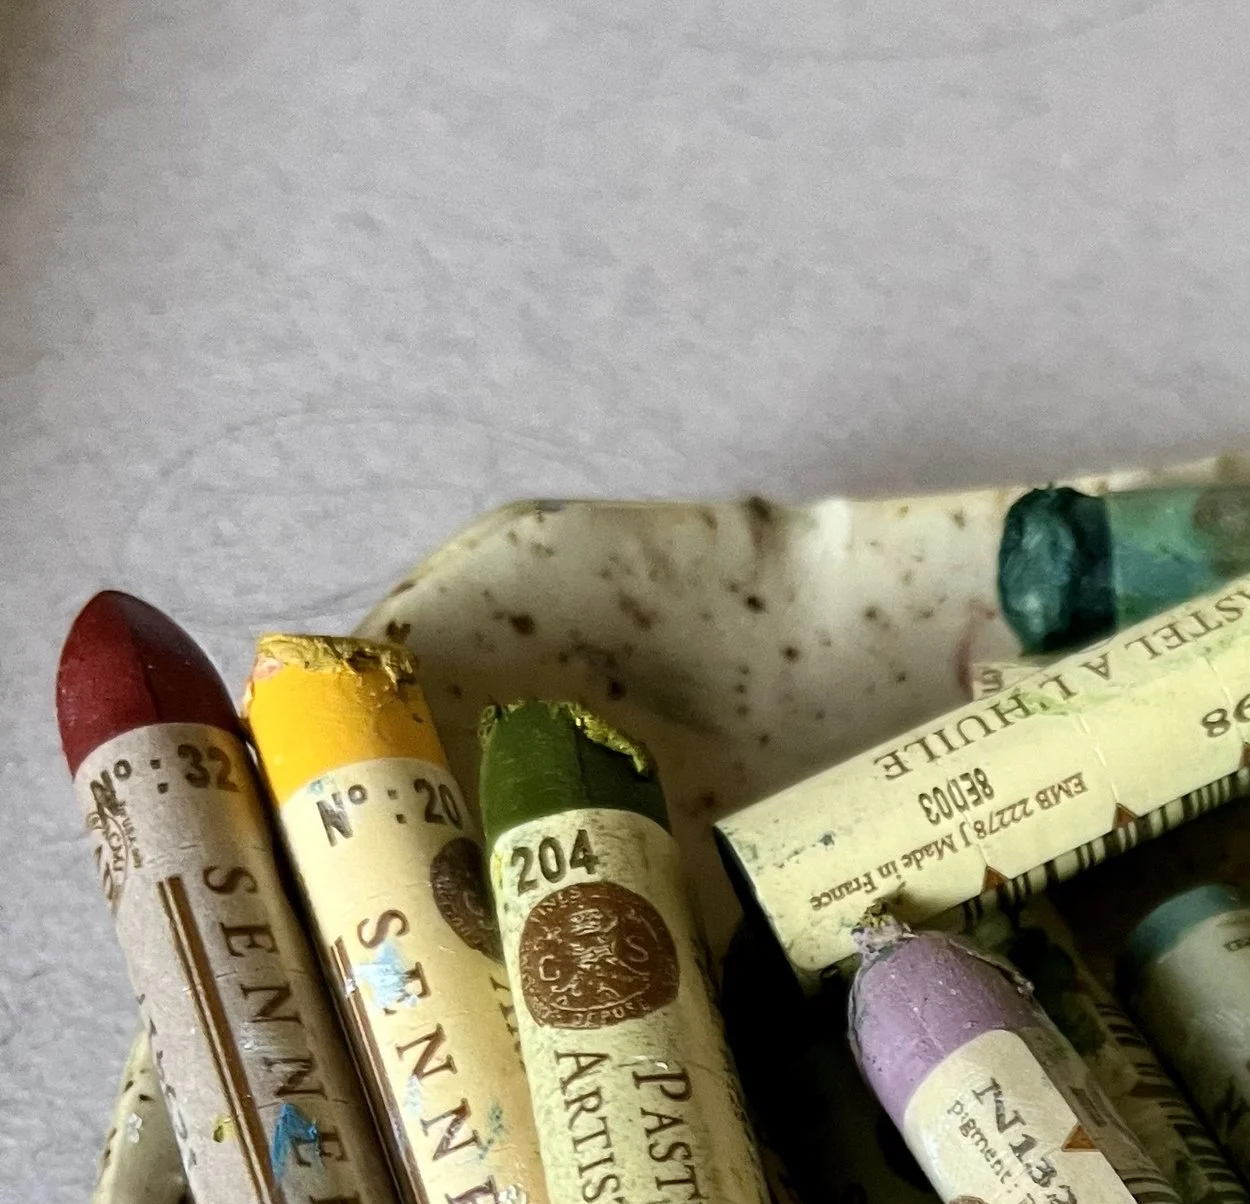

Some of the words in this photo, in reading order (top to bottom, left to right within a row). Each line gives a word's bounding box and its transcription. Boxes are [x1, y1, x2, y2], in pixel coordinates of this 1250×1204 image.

[1077, 649, 1120, 691] A
[868, 670, 1070, 786] L'HUILE
[177, 744, 246, 793] 32
[1029, 769, 1089, 812] EMB
[414, 778, 462, 831] 20
[969, 796, 1037, 842] 22278
[510, 829, 599, 897] 204
[872, 857, 902, 887] in
[897, 831, 959, 877] Made
[808, 869, 878, 917] France
